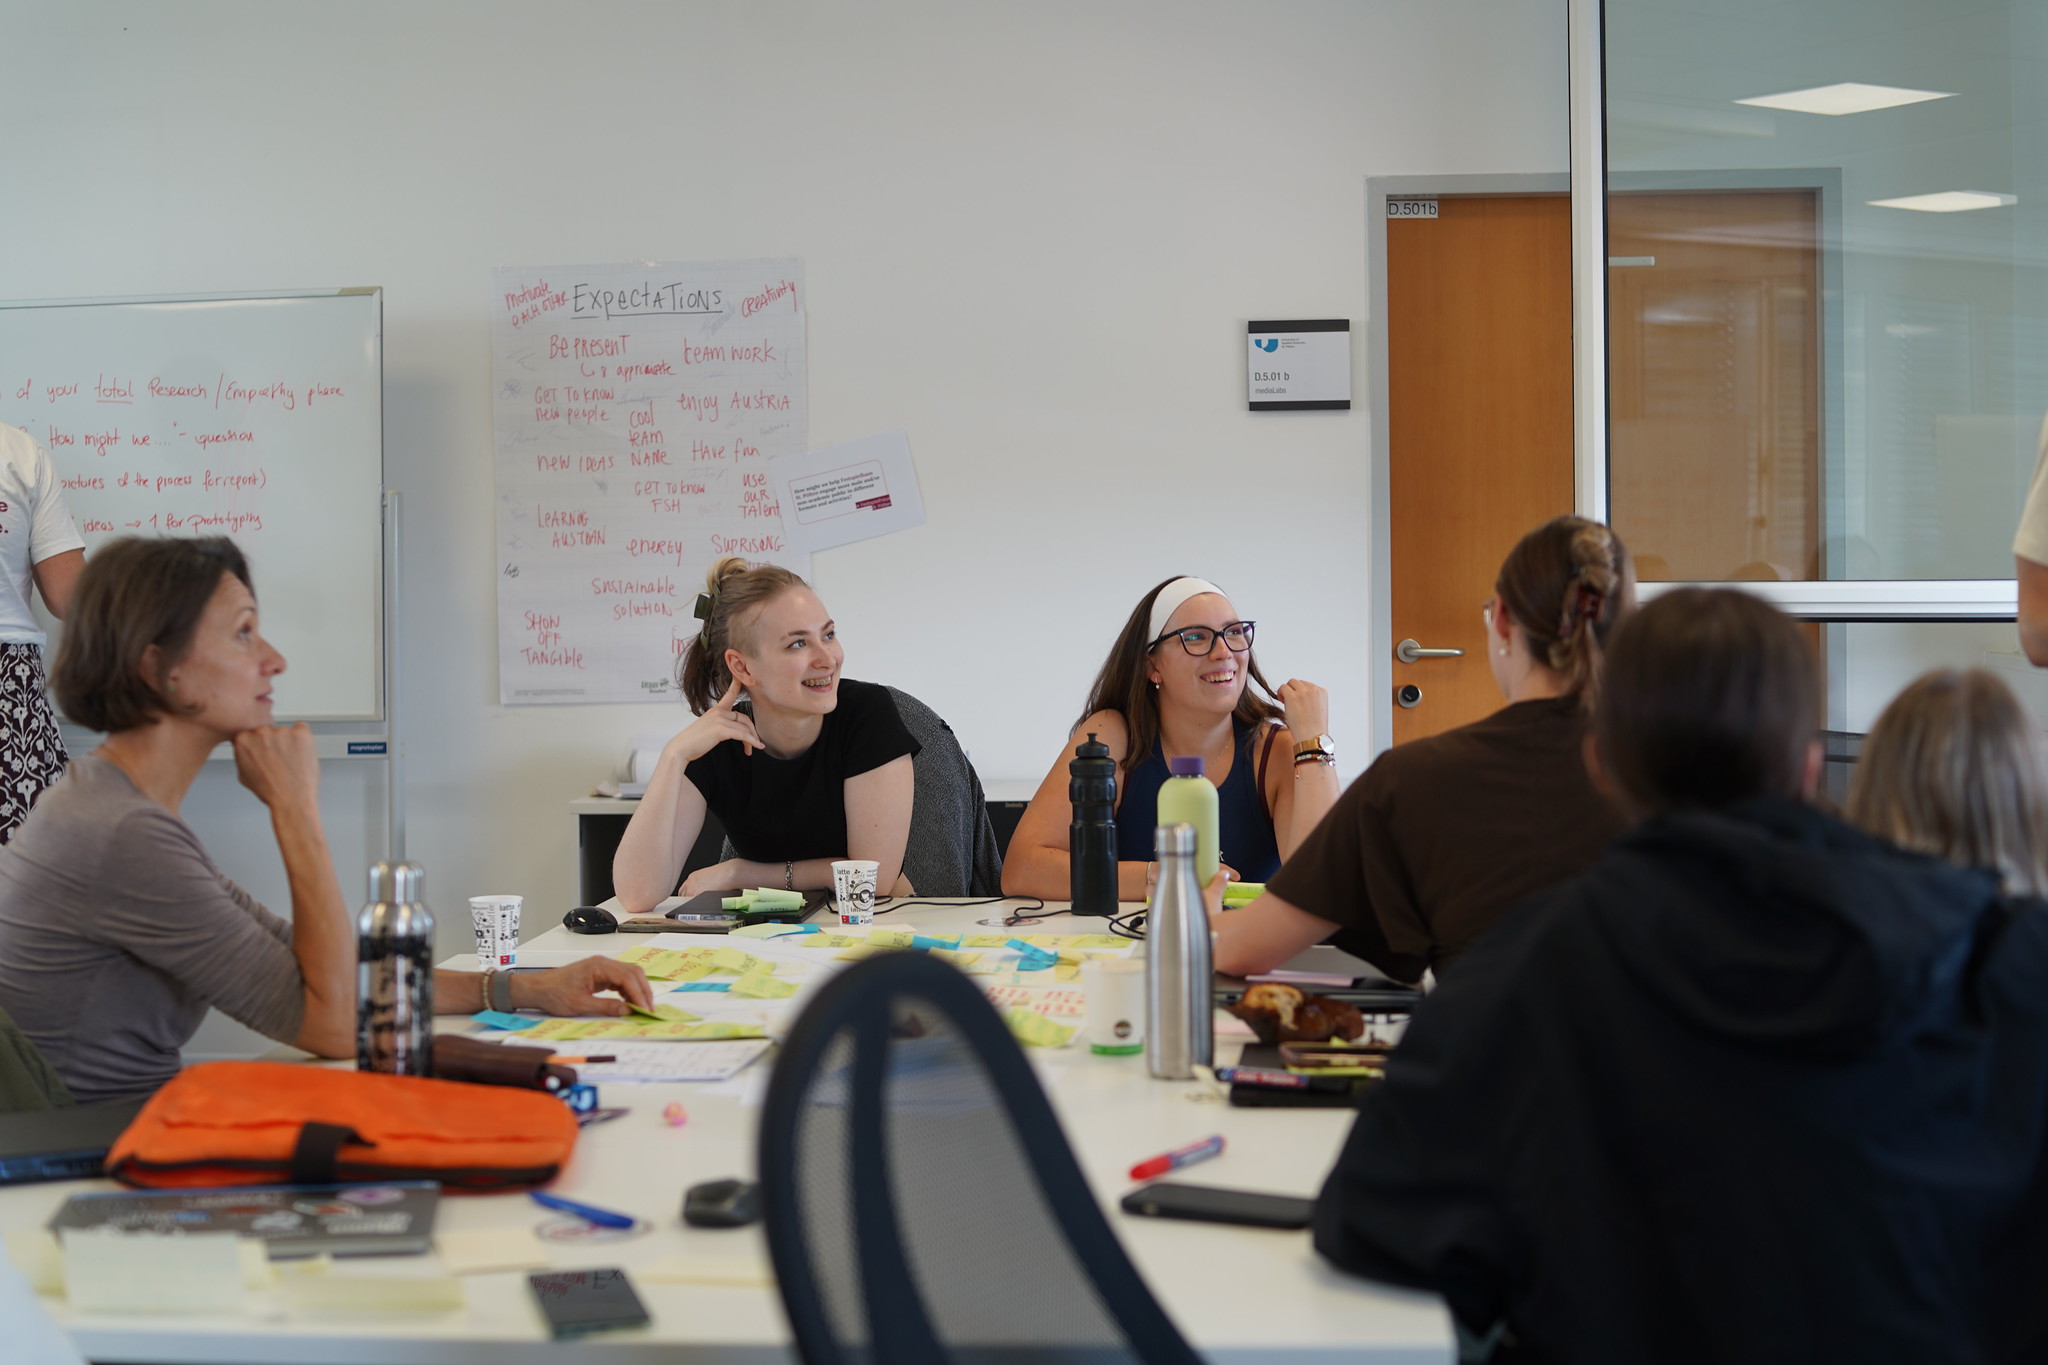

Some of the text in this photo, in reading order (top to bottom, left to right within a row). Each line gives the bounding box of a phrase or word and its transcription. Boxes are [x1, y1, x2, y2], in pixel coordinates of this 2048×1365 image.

[1388, 203, 1437, 215] D.501b
[1284, 371, 1290, 381] b
[46, 383, 78, 404] your
[93, 374, 134, 399] total
[147, 376, 207, 399] Research
[308, 382, 345, 407] phase
[49, 424, 74, 450] How
[84, 427, 121, 457] might
[194, 429, 255, 451] question
[134, 471, 149, 488] the
[156, 475, 192, 493] process
[203, 469, 222, 492] for
[82, 519, 114, 533] ideas
[166, 512, 184, 530] for
